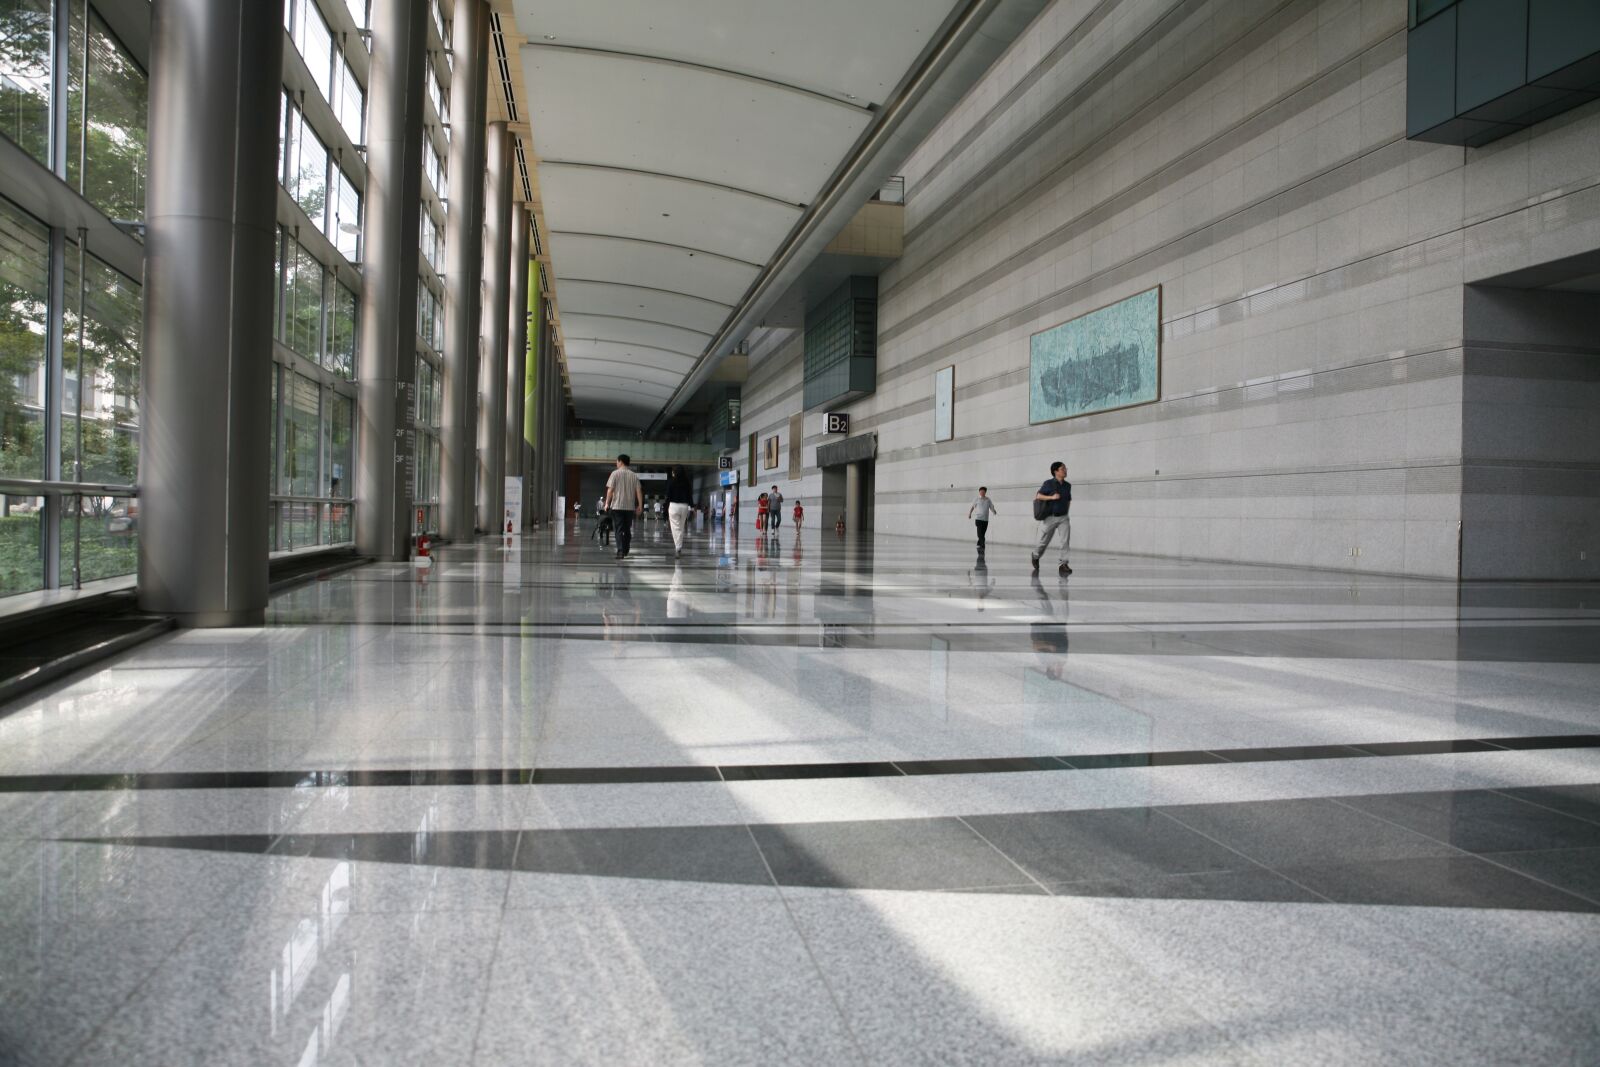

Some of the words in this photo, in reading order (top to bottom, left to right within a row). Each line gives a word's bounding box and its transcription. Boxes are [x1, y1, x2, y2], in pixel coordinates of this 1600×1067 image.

[398, 382, 406, 390] 1F
[830, 416, 847, 431] B2
[396, 429, 404, 437] 2F
[721, 458, 731, 467] B1
